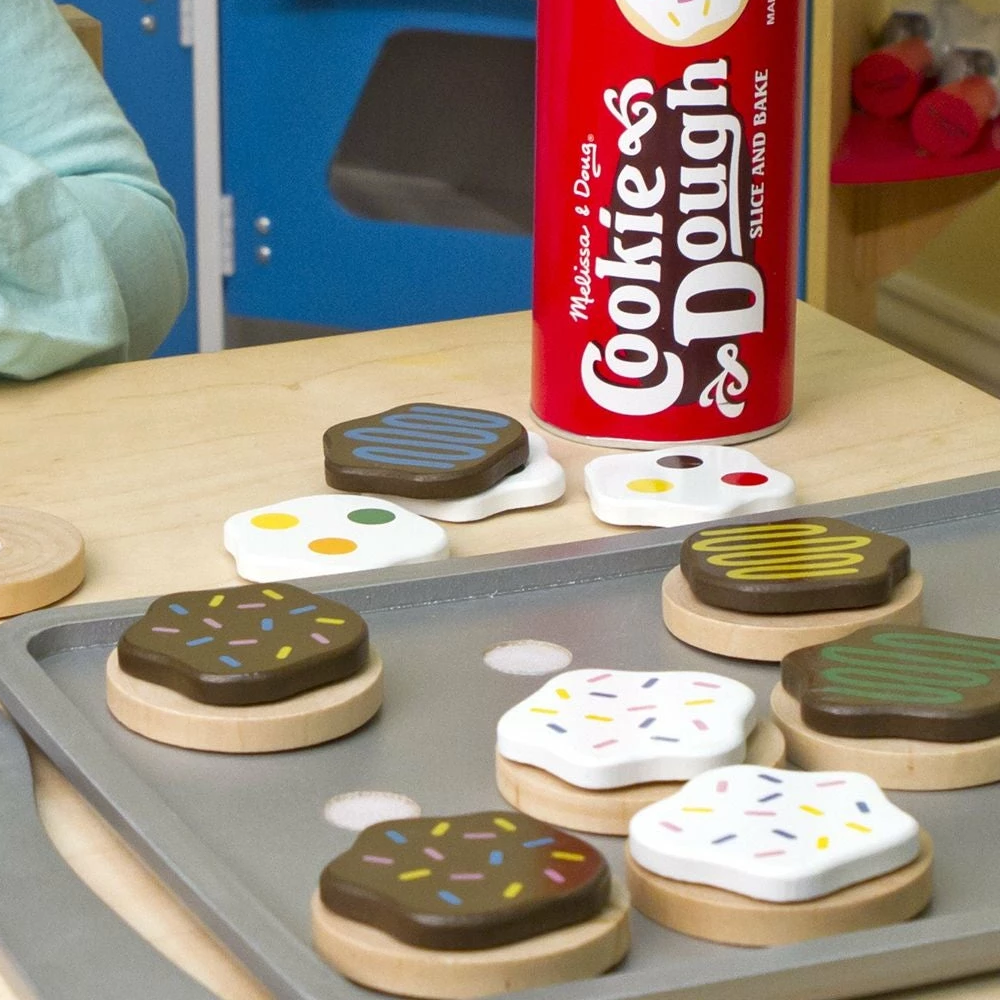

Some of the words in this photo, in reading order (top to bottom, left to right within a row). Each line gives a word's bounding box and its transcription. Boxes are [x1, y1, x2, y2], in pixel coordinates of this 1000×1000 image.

[753, 68, 769, 125] BAKE
[750, 130, 767, 177] AND
[574, 205, 590, 217] &
[666, 57, 765, 347] Dough
[749, 181, 765, 240] SLICE
[569, 225, 595, 322] Melissa
[580, 164, 685, 416] Cookie
